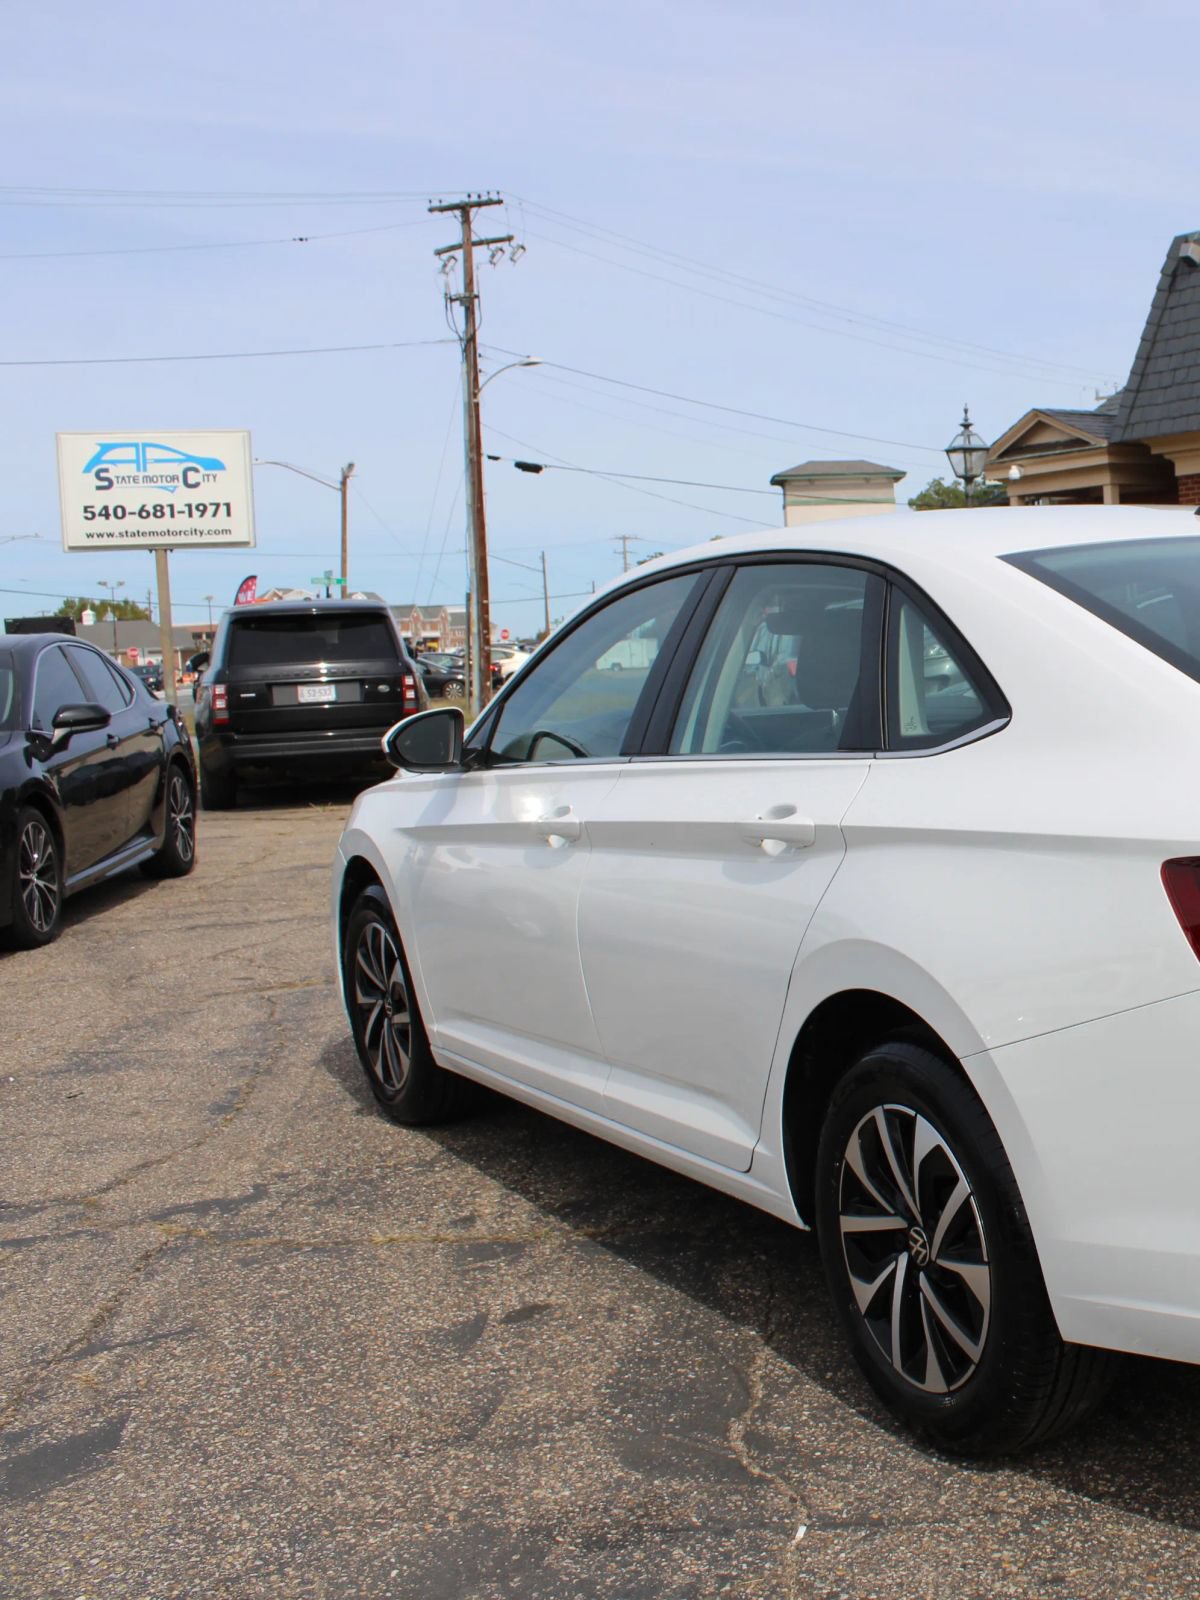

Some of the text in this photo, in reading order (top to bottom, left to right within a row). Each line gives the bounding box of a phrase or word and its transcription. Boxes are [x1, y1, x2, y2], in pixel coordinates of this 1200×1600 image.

[94, 466, 218, 491] STATE MOTOR CITY
[82, 503, 232, 521] 540-681-1971
[85, 527, 232, 539] www.statemotorcity.com
